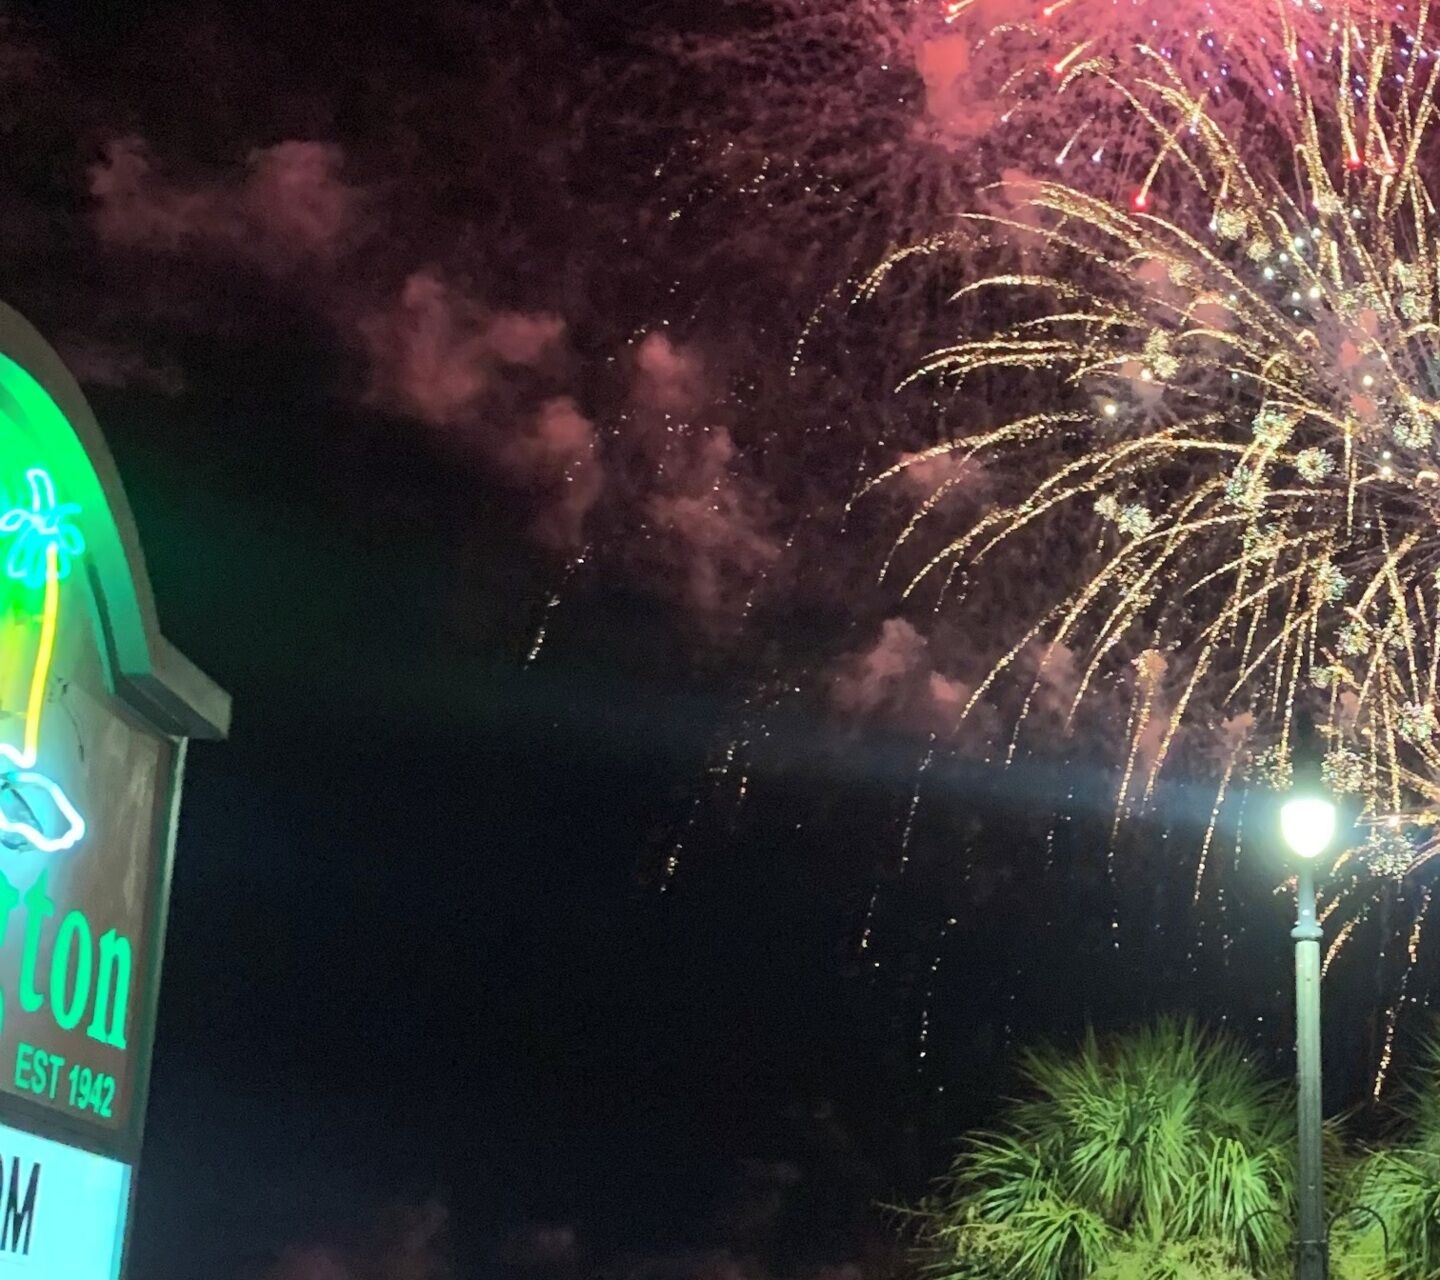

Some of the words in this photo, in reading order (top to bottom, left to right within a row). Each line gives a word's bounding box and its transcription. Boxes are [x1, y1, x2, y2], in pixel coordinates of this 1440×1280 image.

[0, 870, 131, 1049] ton
[14, 1041, 65, 1099] EST
[68, 1064, 116, 1118] 1942
